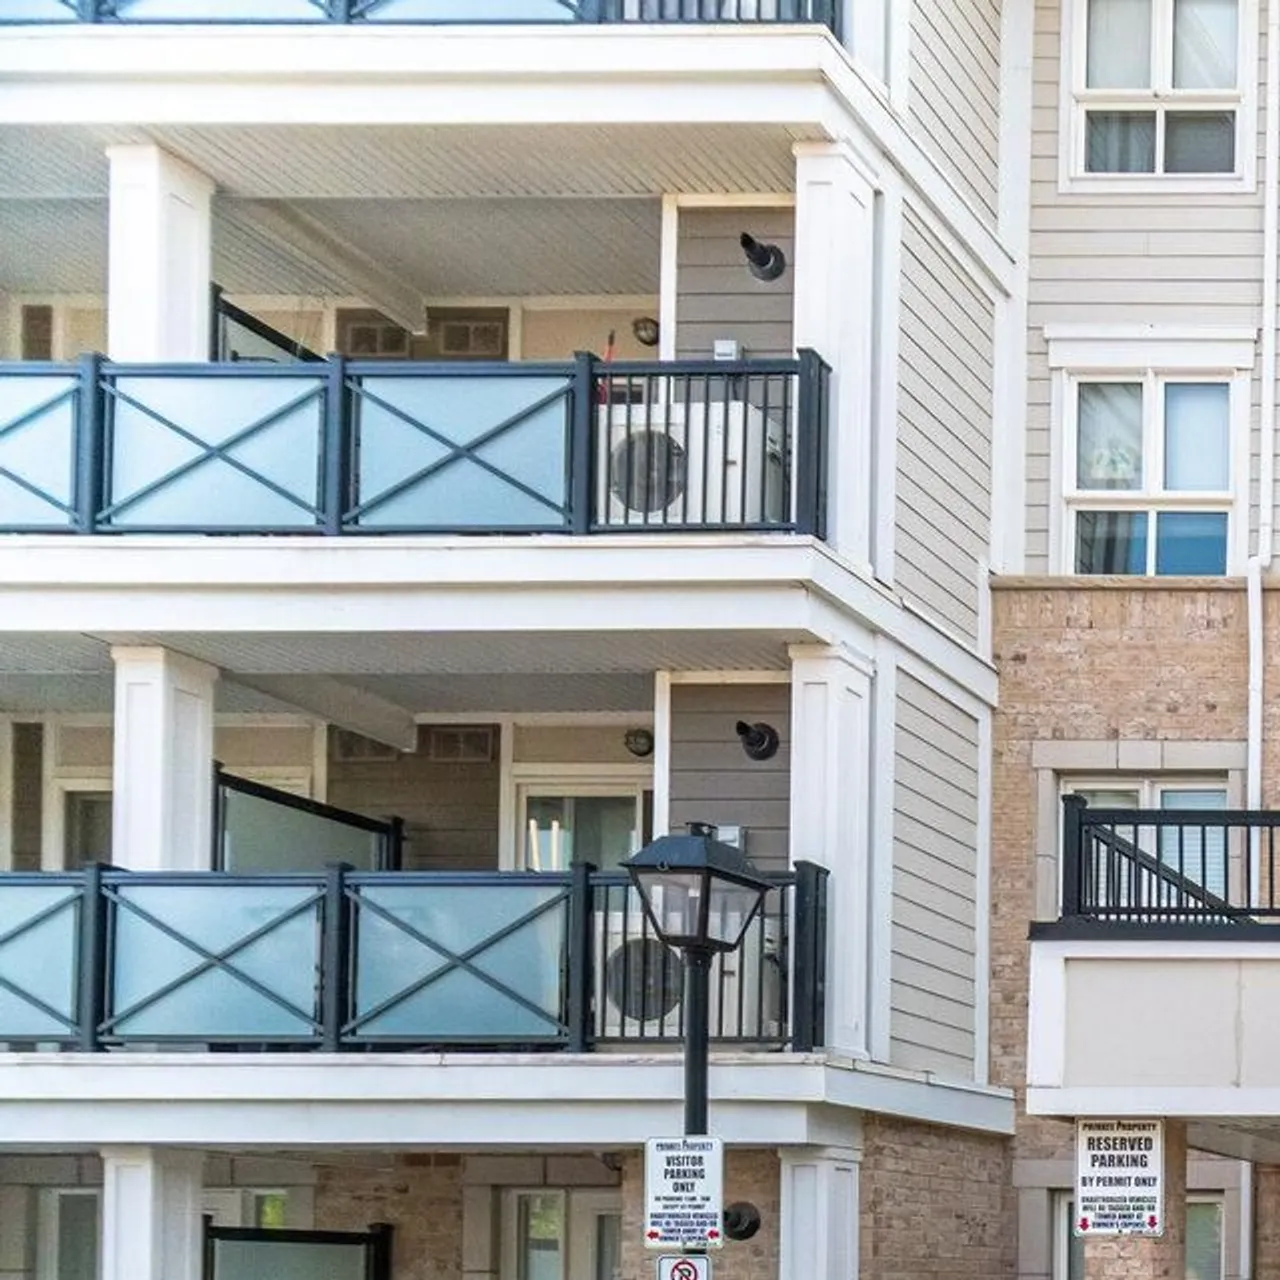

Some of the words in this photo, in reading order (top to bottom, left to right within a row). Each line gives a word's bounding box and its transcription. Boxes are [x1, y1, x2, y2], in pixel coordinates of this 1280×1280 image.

[1087, 1136, 1154, 1151] RESERVED
[666, 1155, 704, 1167] VISITOR
[1090, 1154, 1148, 1168] PARKING
[664, 1168, 705, 1179] PARKING
[1081, 1176, 1094, 1187] BY
[1096, 1176, 1133, 1187] PERMIT
[1134, 1176, 1157, 1187] ONLY
[672, 1182, 695, 1193] ONLY
